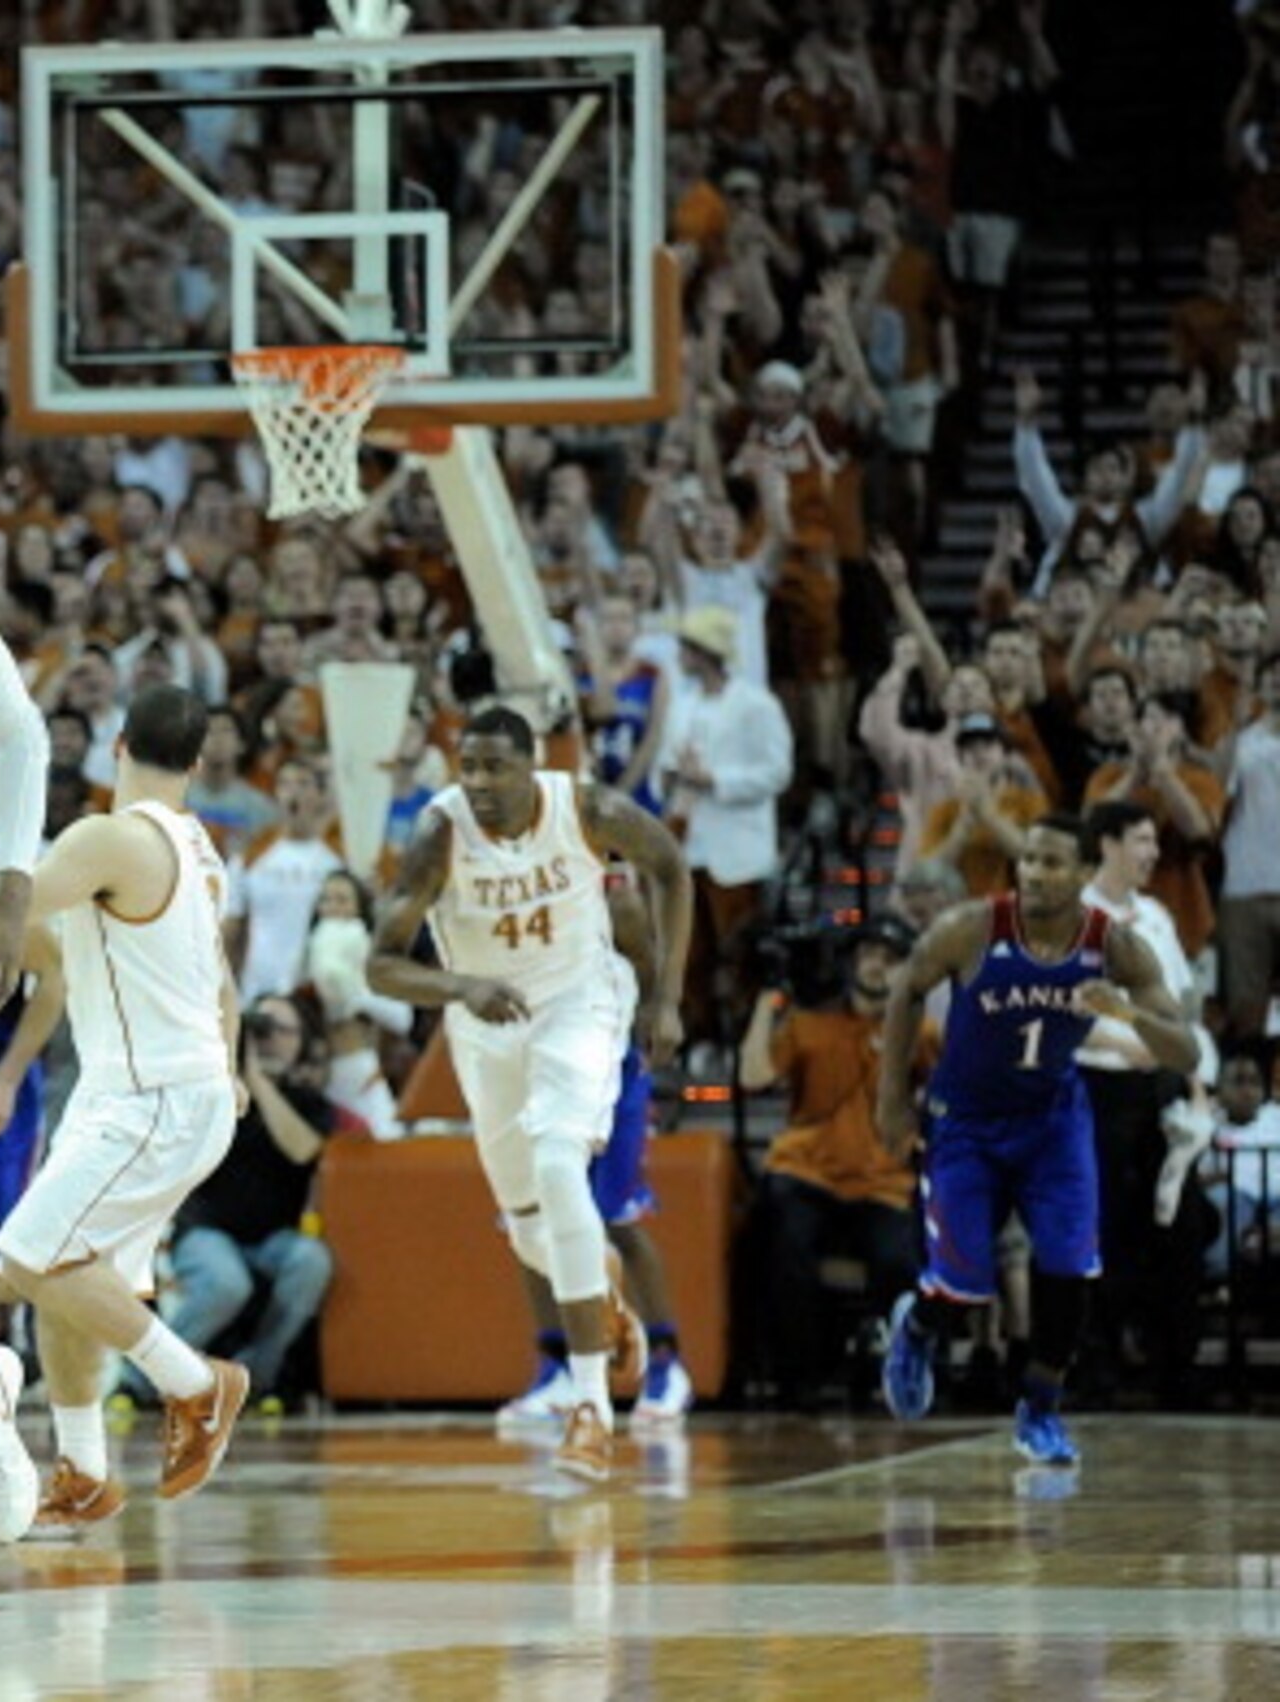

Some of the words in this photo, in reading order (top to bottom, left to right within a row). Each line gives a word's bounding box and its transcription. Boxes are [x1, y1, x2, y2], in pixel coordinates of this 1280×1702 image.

[474, 857, 570, 909] TEXAS
[492, 905, 552, 948] 44
[1019, 1018, 1043, 1069] 1
